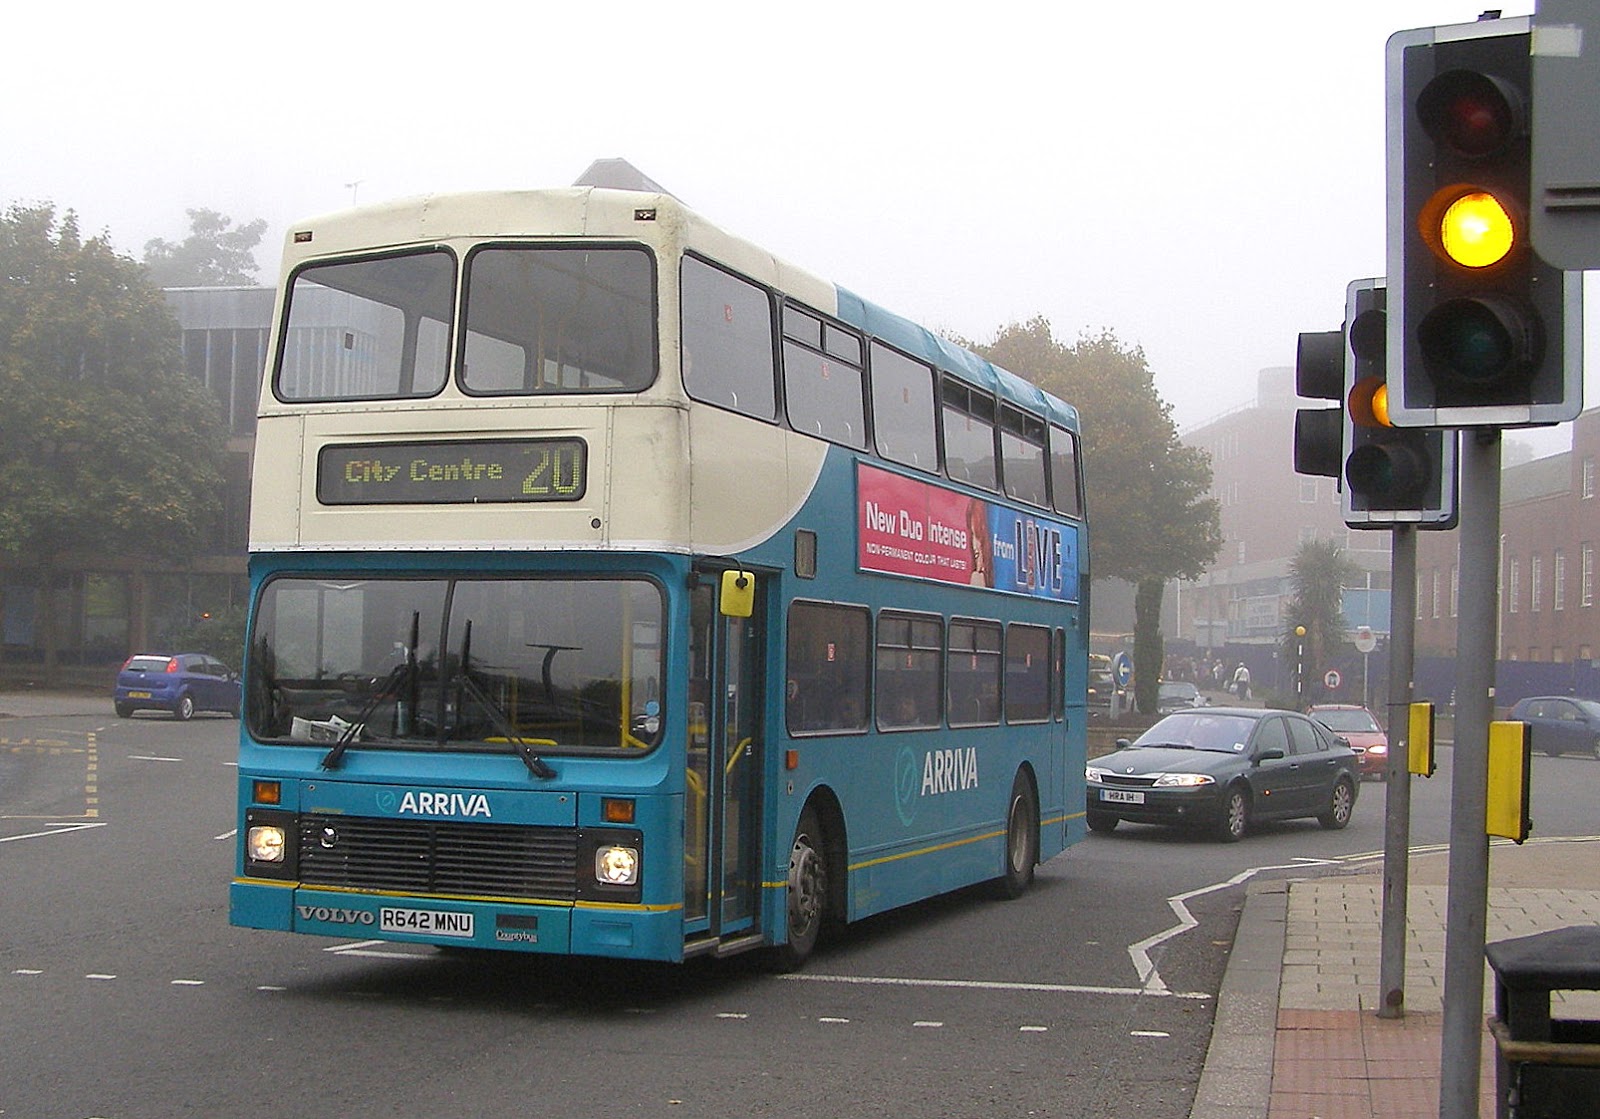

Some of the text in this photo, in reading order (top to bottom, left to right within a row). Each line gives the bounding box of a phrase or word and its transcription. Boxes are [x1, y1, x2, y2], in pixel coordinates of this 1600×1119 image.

[345, 448, 580, 494] City Centre 20
[866, 501, 967, 549] New Duo Intense
[866, 542, 914, 561] NON-PERMANENT
[914, 552, 937, 565] COLOUR
[993, 533, 1015, 560] from
[920, 747, 978, 796] ARRIVA
[399, 791, 492, 818] ARRIVA
[297, 905, 375, 926] VOLVO
[382, 909, 471, 932] R642 MNU
